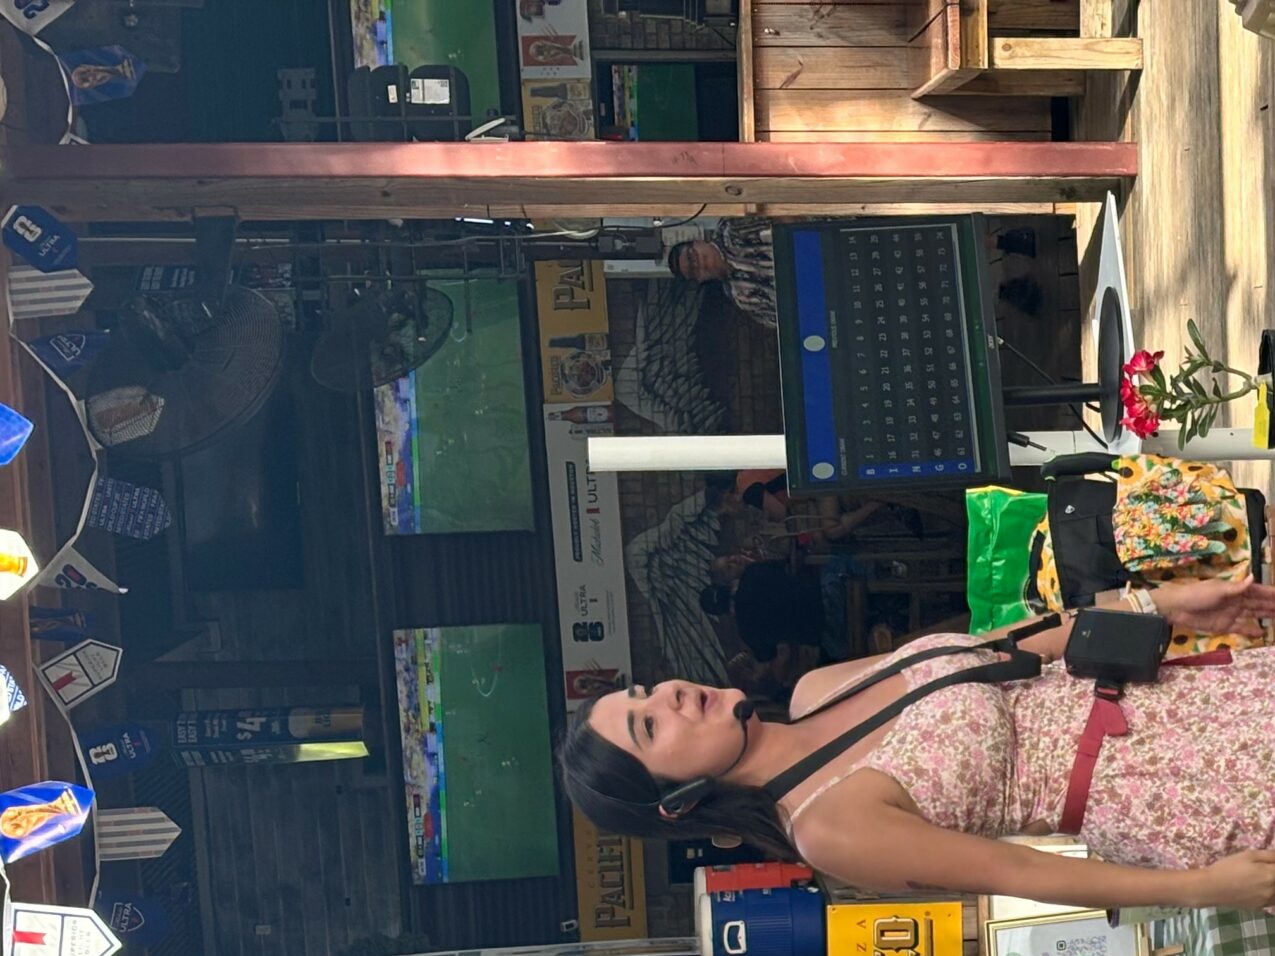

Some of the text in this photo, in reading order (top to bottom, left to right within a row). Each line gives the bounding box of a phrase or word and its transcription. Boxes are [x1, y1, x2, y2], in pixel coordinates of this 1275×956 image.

[568, 463, 577, 494] HOUSTON
[935, 464, 945, 472] G
[579, 584, 589, 616] ULTRA
[122, 732, 137, 759] ULTRA
[592, 836, 631, 928] PACIFI
[119, 902, 133, 933] ULTRA
